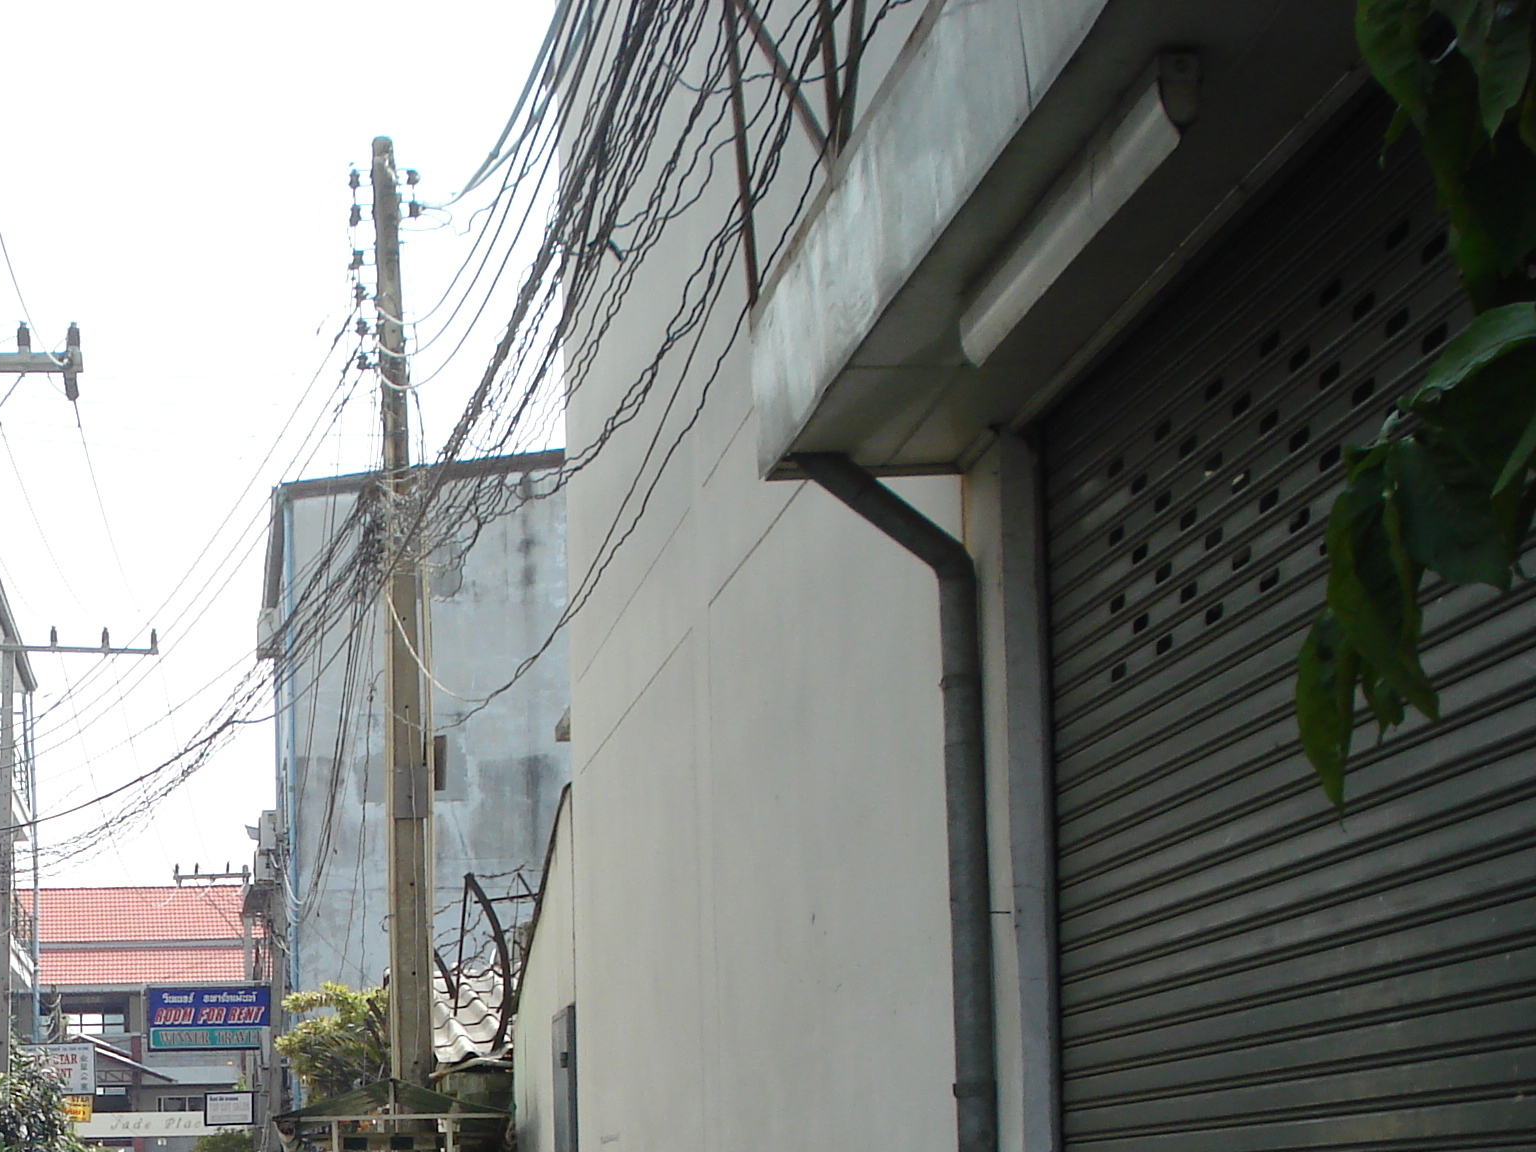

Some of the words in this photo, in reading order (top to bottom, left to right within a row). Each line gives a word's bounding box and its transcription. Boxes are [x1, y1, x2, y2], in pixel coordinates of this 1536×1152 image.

[154, 1007, 196, 1025] ROOM
[197, 1006, 226, 1025] FOR
[227, 1006, 265, 1024] RENT
[159, 1031, 210, 1044] WINNER
[111, 1115, 151, 1130] Jade
[164, 1117, 202, 1130] Plac
